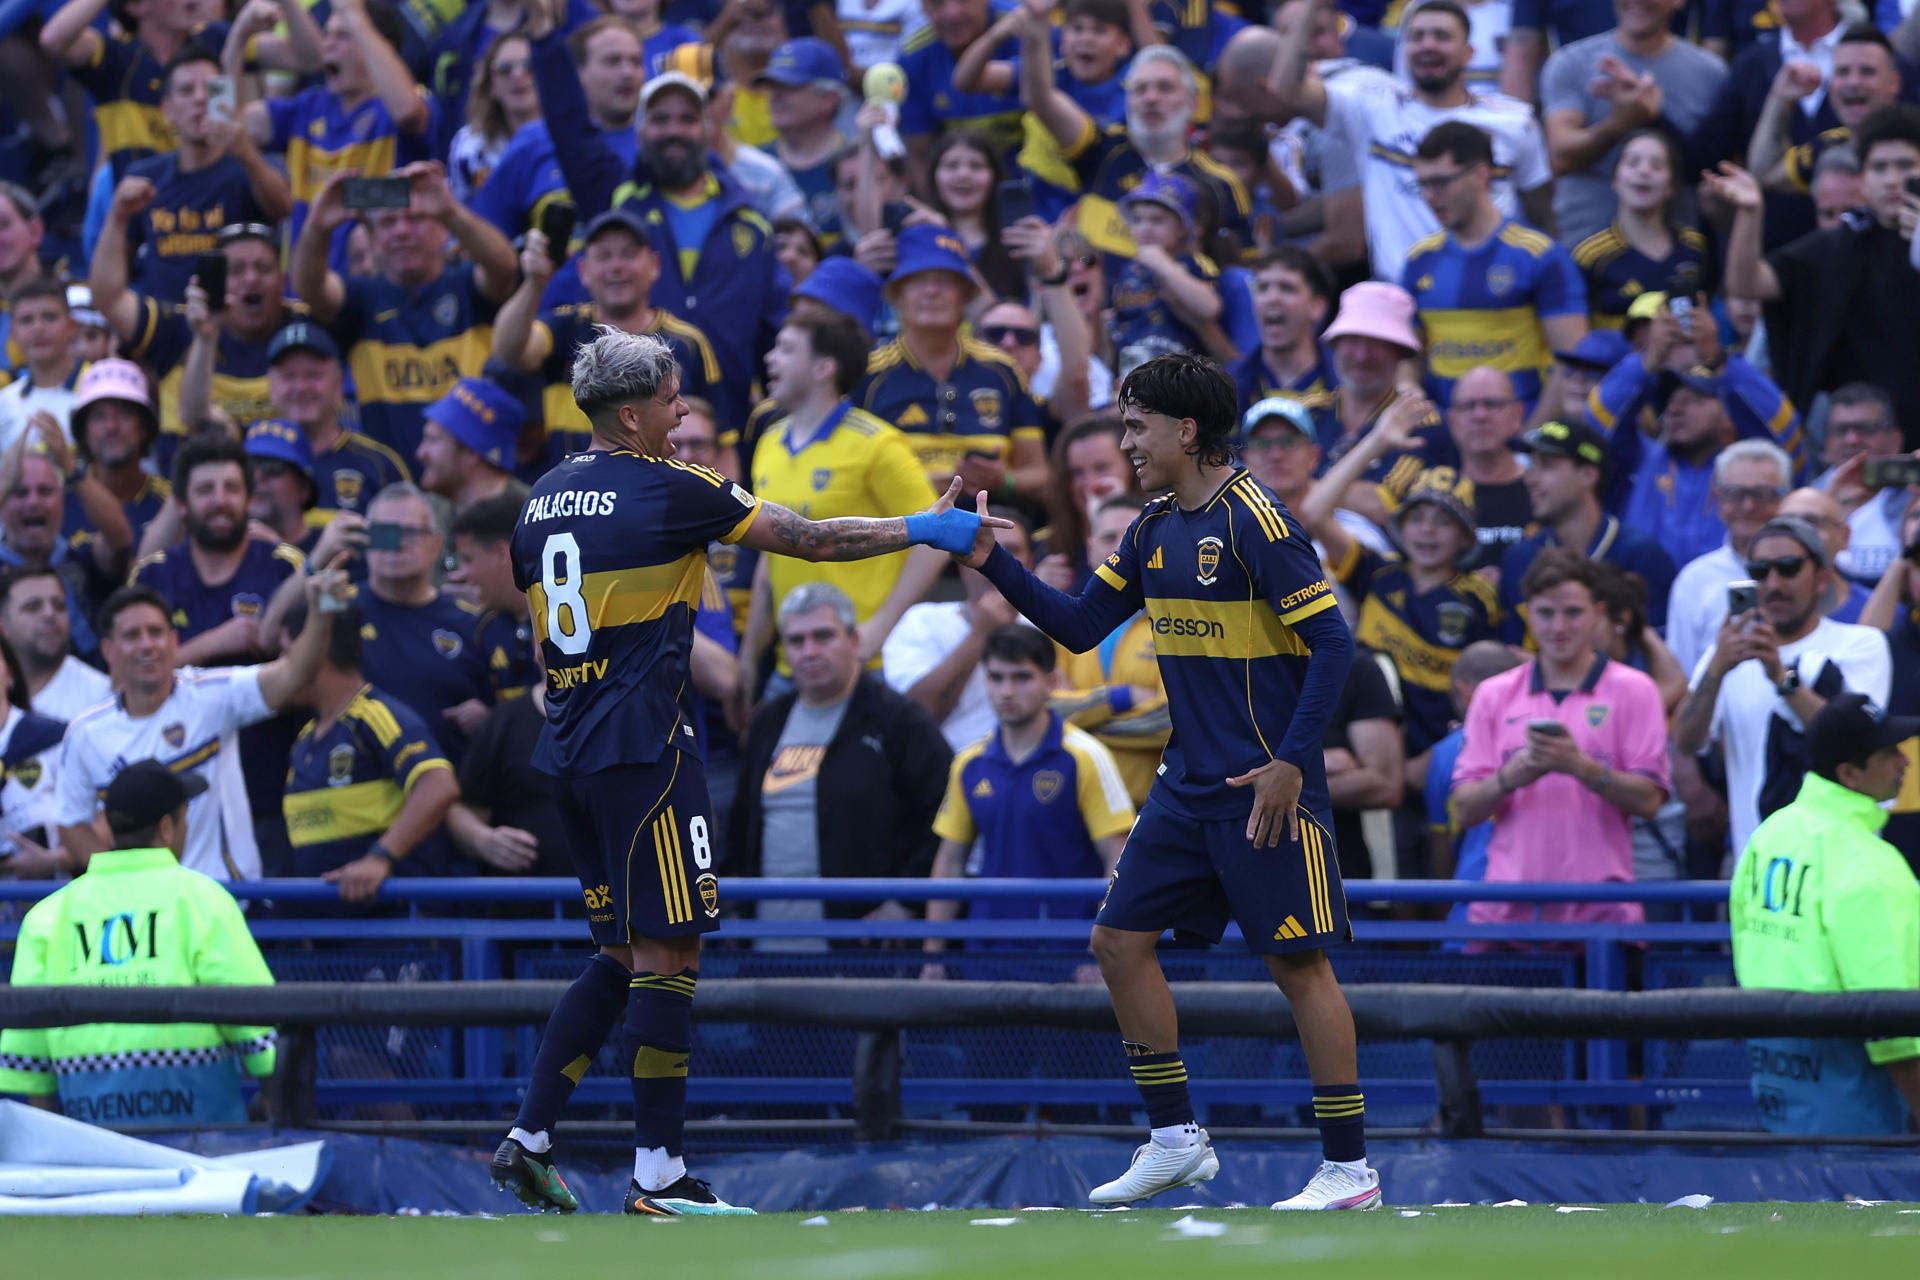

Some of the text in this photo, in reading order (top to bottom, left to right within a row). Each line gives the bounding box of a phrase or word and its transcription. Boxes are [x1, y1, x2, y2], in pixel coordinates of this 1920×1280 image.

[524, 490, 617, 525] PALACIOS
[542, 532, 592, 655] 8
[689, 815, 712, 870] 8
